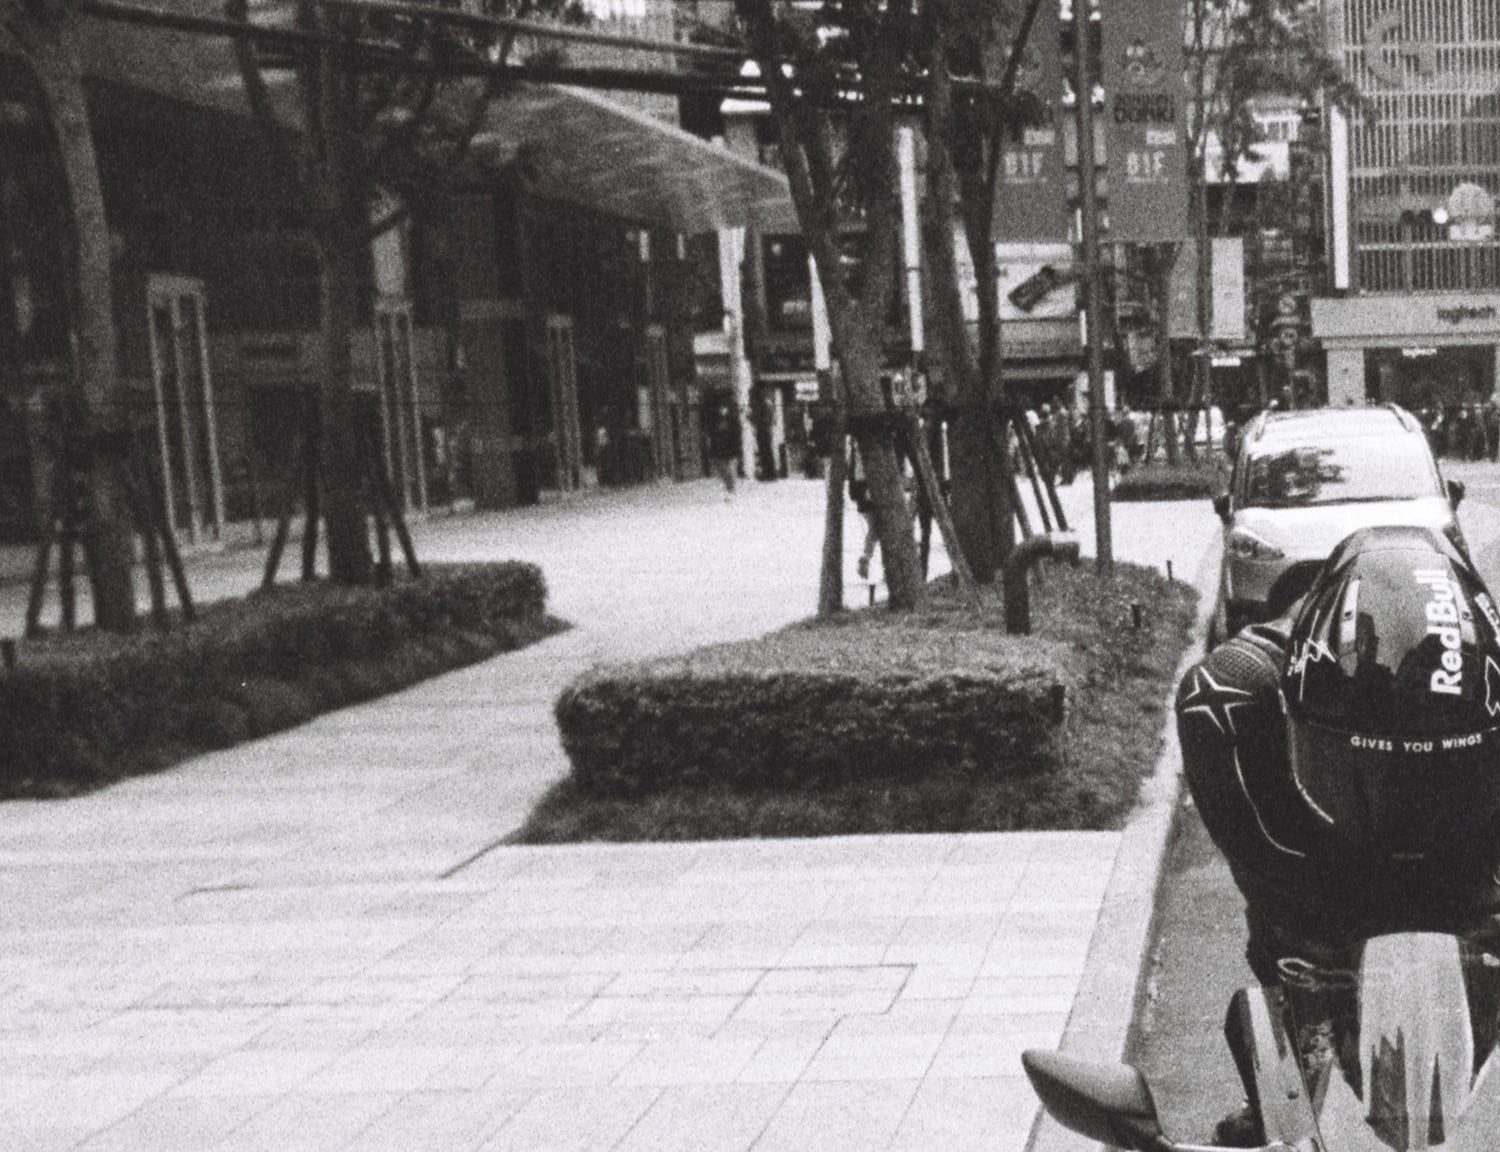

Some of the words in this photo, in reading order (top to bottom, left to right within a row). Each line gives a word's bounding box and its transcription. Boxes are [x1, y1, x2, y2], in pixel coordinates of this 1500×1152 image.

[1351, 736, 1393, 751] GIVES
[1404, 741, 1433, 752] YOU
[1442, 733, 1482, 749] WINGS
